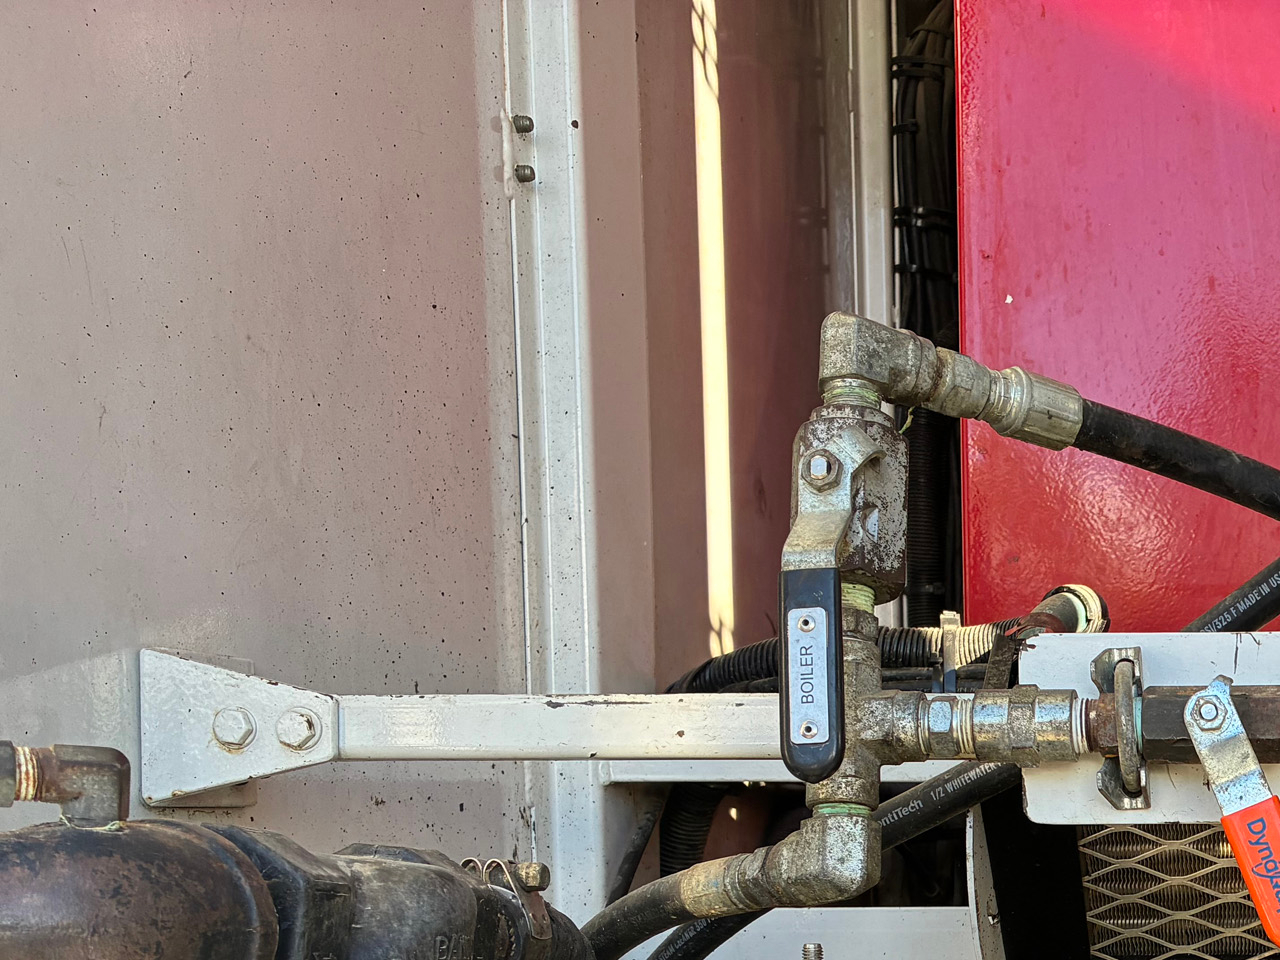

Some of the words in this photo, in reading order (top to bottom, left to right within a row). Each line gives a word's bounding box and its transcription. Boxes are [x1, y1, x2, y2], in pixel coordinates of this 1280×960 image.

[1200, 611, 1232, 633] SI/325
[1236, 589, 1261, 613] MADE
[1258, 582, 1271, 596] IN
[800, 644, 815, 704] BOILER
[930, 786, 946, 801] 1/2
[944, 762, 997, 794] WHITEWATER
